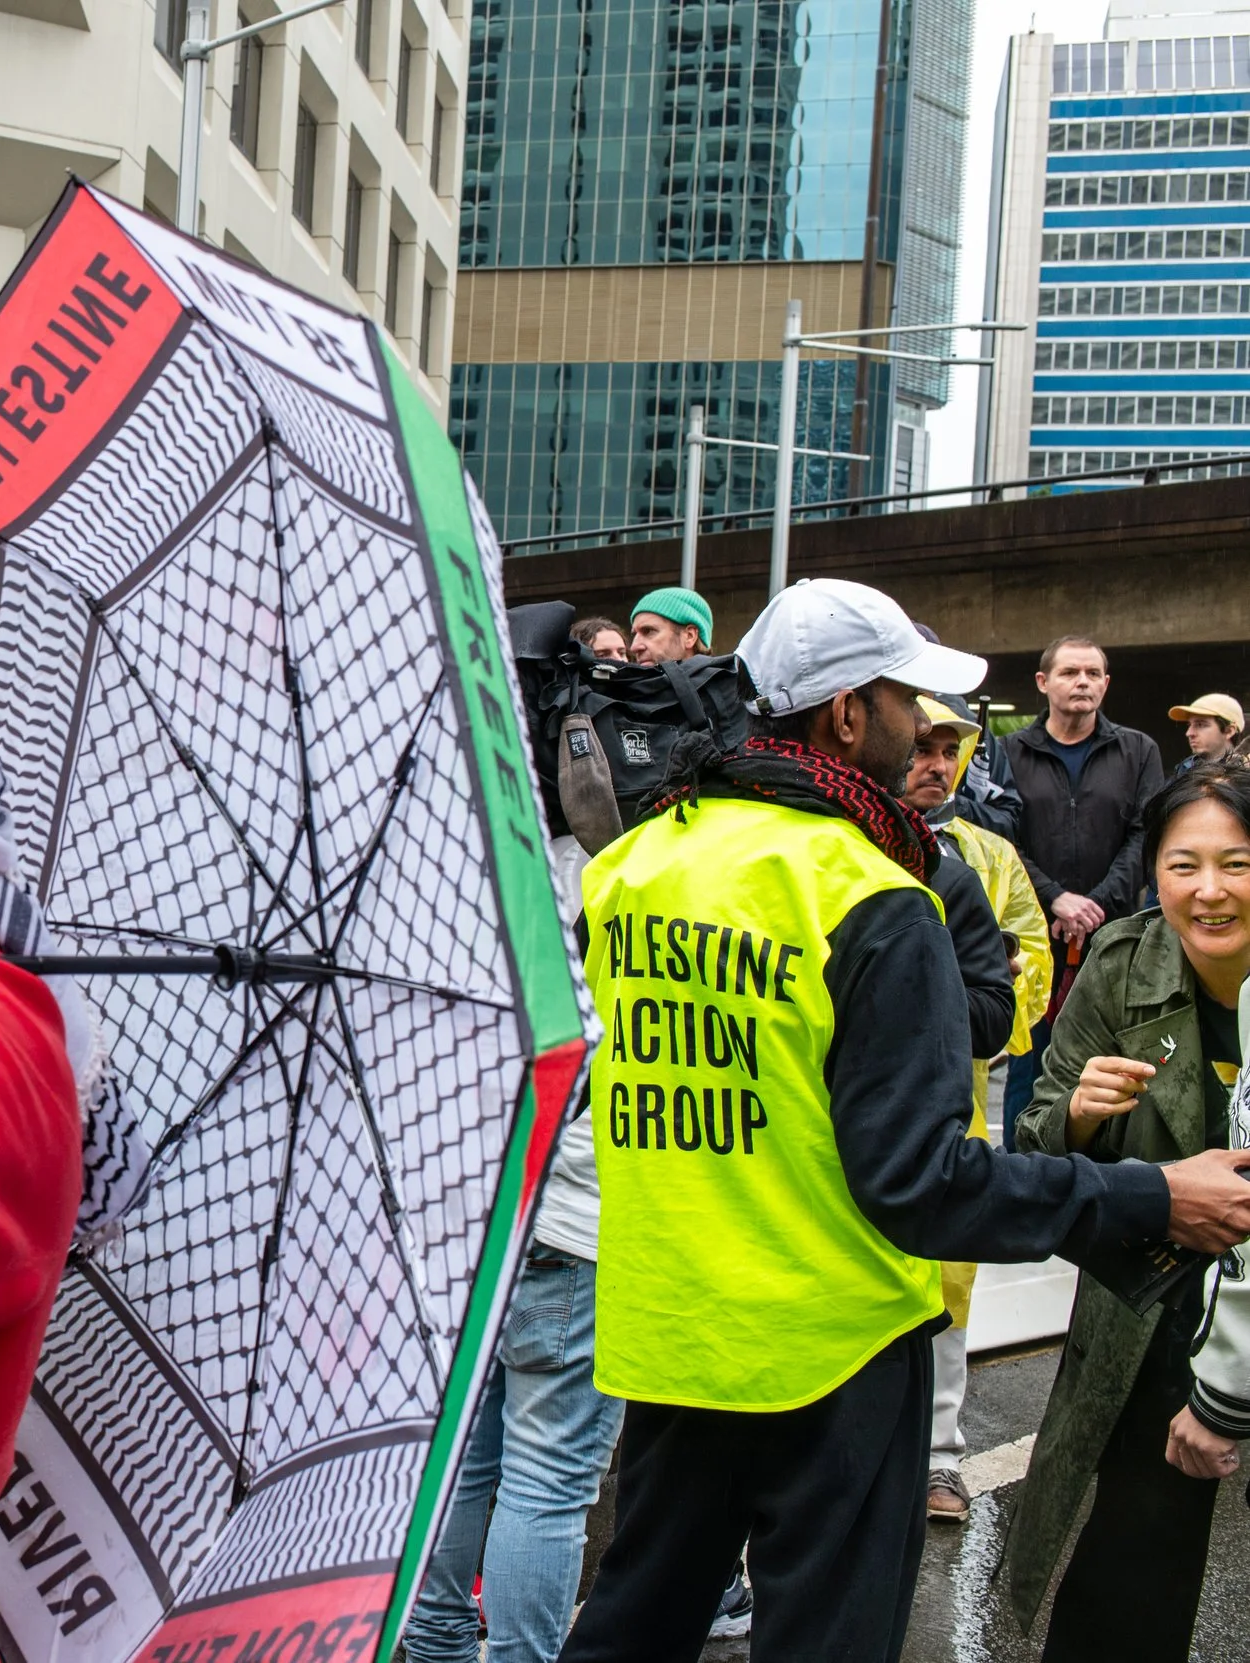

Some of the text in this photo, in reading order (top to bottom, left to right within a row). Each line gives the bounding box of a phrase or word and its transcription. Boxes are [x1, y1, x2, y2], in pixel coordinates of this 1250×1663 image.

[603, 912, 804, 1005] ALESTINE
[612, 997, 759, 1081] ACTION
[610, 1081, 768, 1156] GROUP
